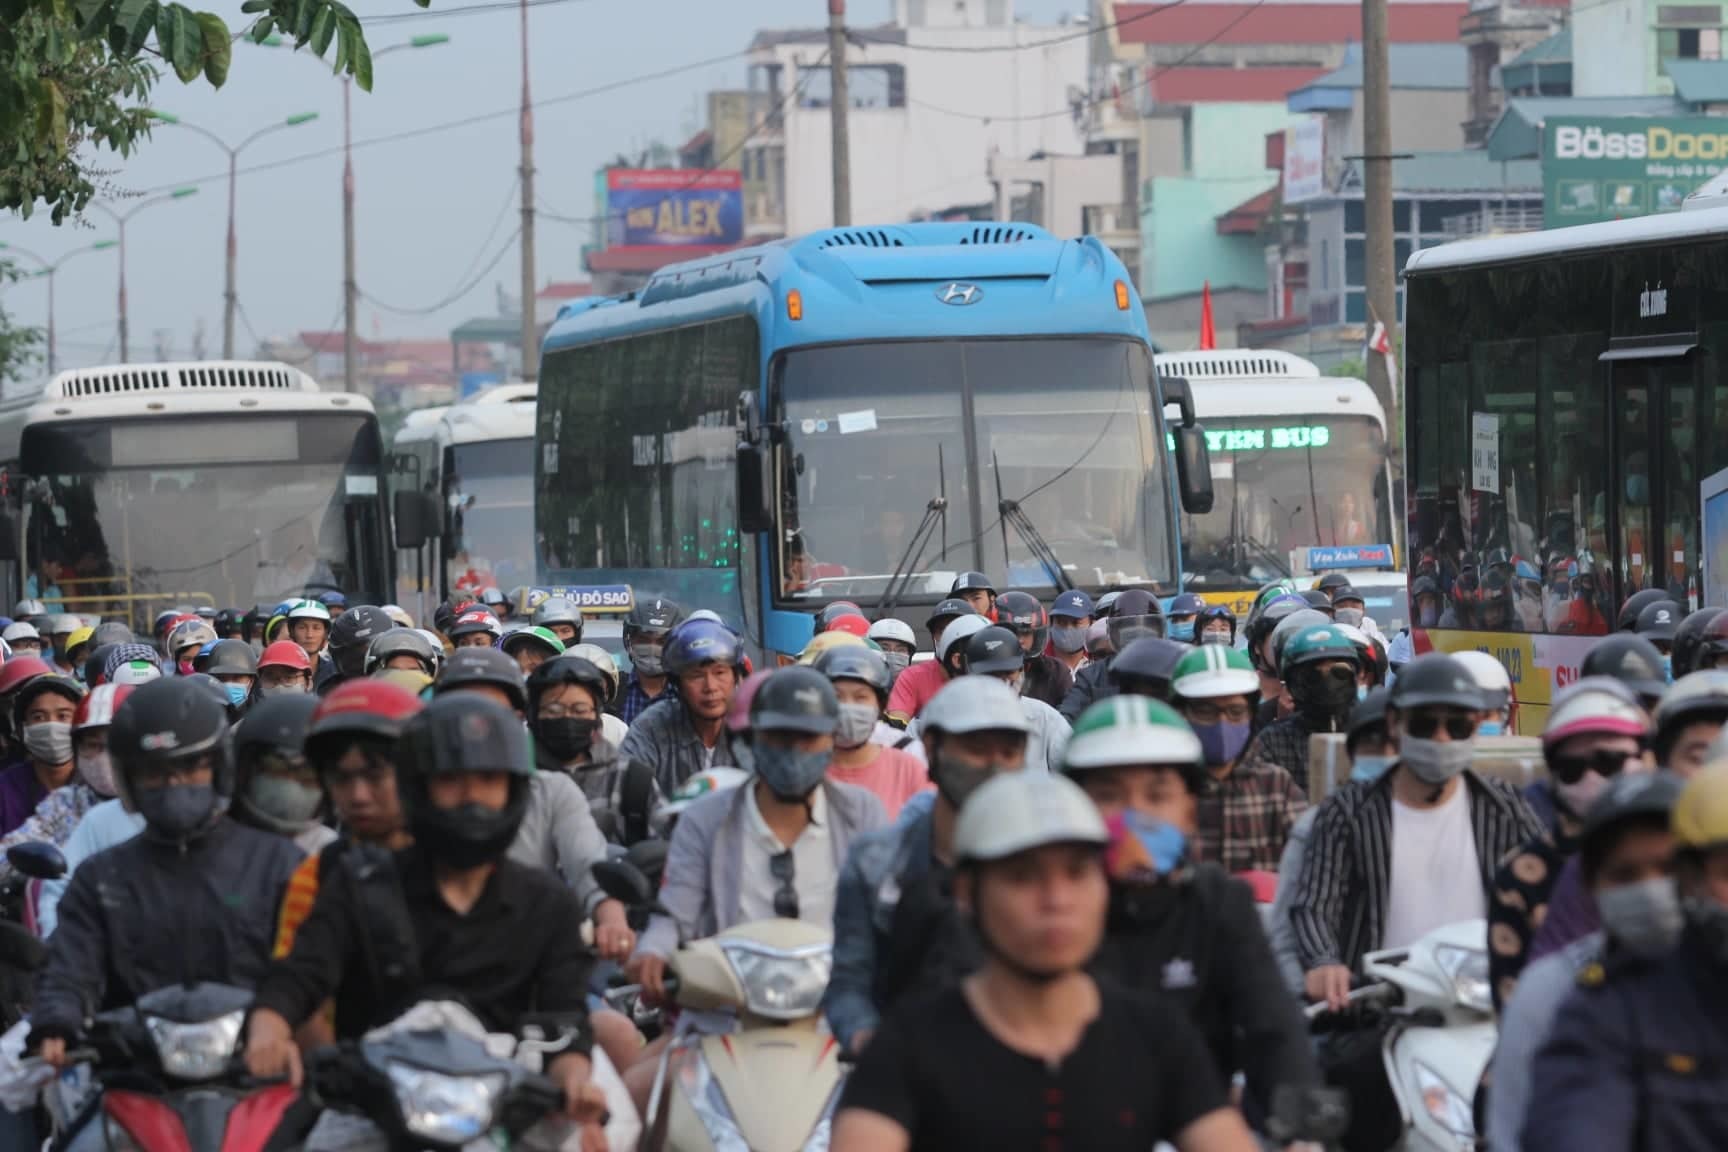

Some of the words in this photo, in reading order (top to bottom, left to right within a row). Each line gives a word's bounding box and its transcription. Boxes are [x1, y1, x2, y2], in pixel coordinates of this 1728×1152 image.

[656, 199, 724, 236] ALEX
[1271, 426, 1329, 448] BUS
[603, 591, 630, 605] SAO
